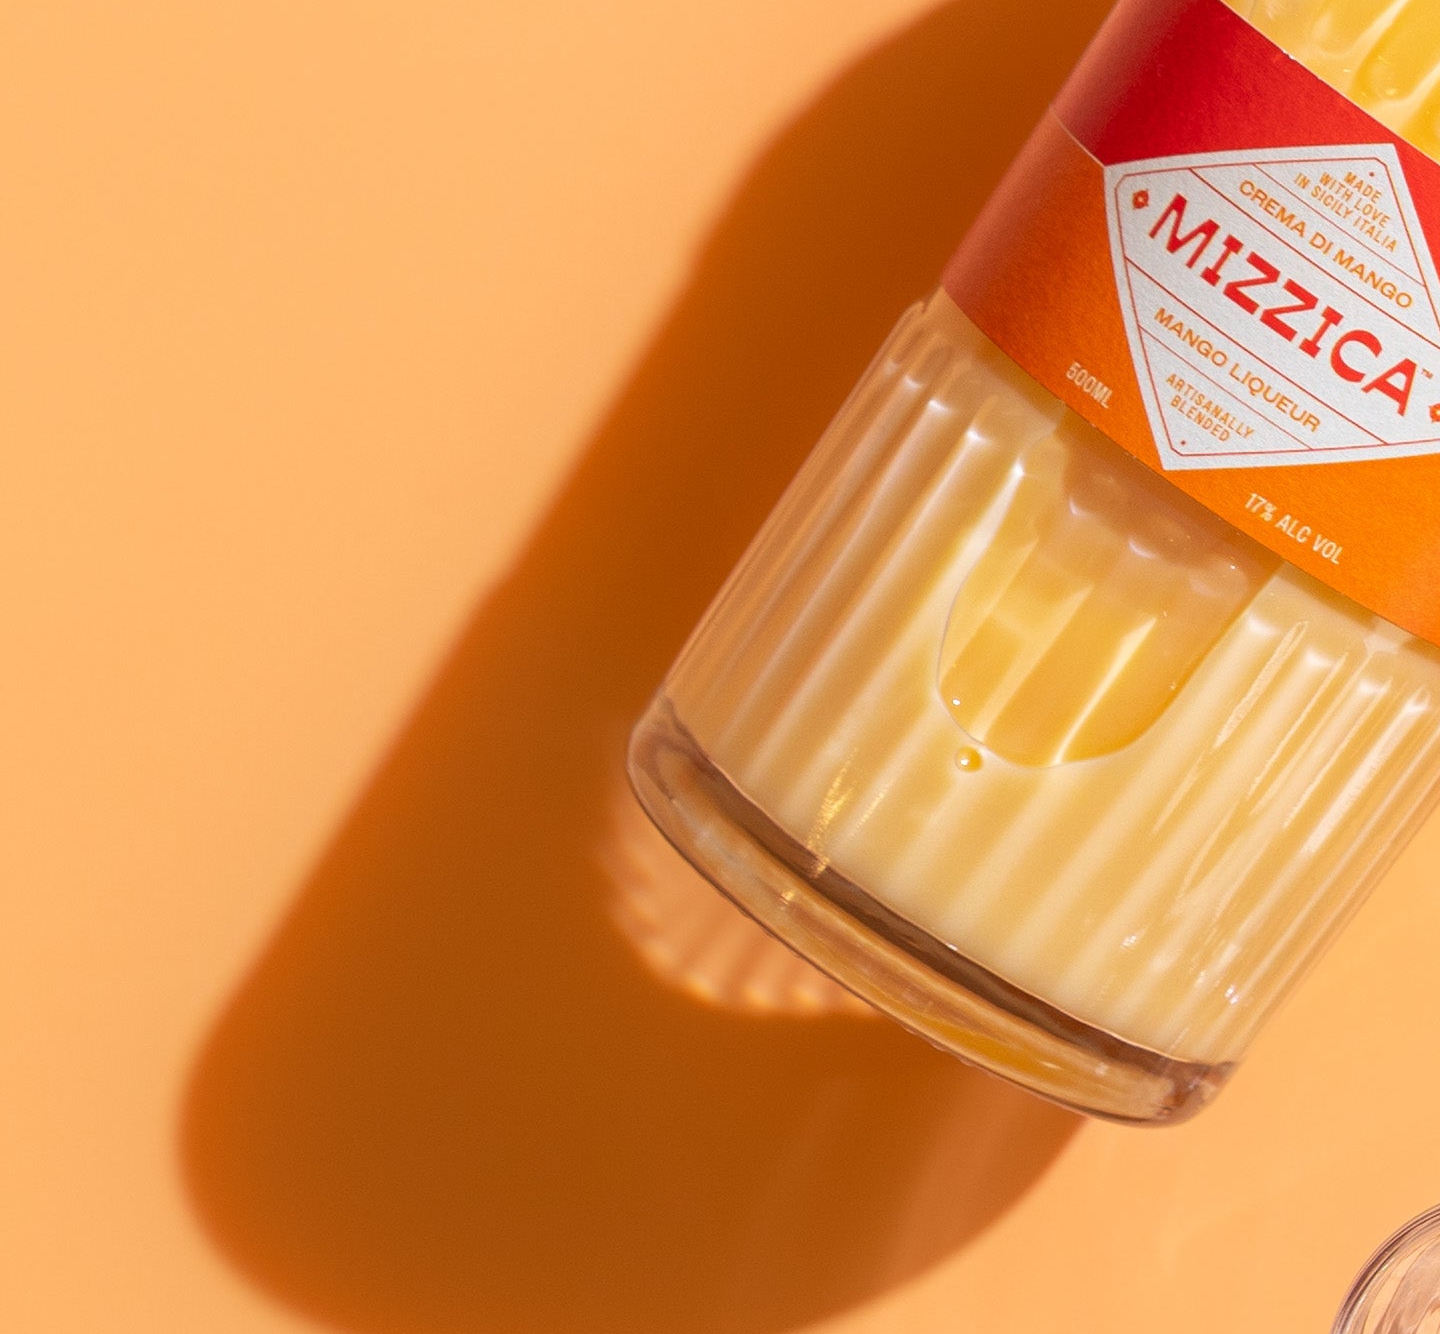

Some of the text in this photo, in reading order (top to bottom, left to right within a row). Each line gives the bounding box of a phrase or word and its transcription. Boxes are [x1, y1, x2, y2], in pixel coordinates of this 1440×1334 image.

[1294, 173, 1397, 252] IN SICILY ITALIA
[1320, 172, 1390, 228] WITH LOVE
[1344, 172, 1382, 204] MADE
[1239, 180, 1412, 308] CREMA DI MANGO
[1066, 361, 1112, 408] 500ML
[1154, 307, 1321, 432] MANGO LIQUEUR
[1166, 373, 1255, 439] ARTISANALLY
[1171, 397, 1230, 441] BLENDED
[1244, 492, 1347, 565] 17% ALC VOL
